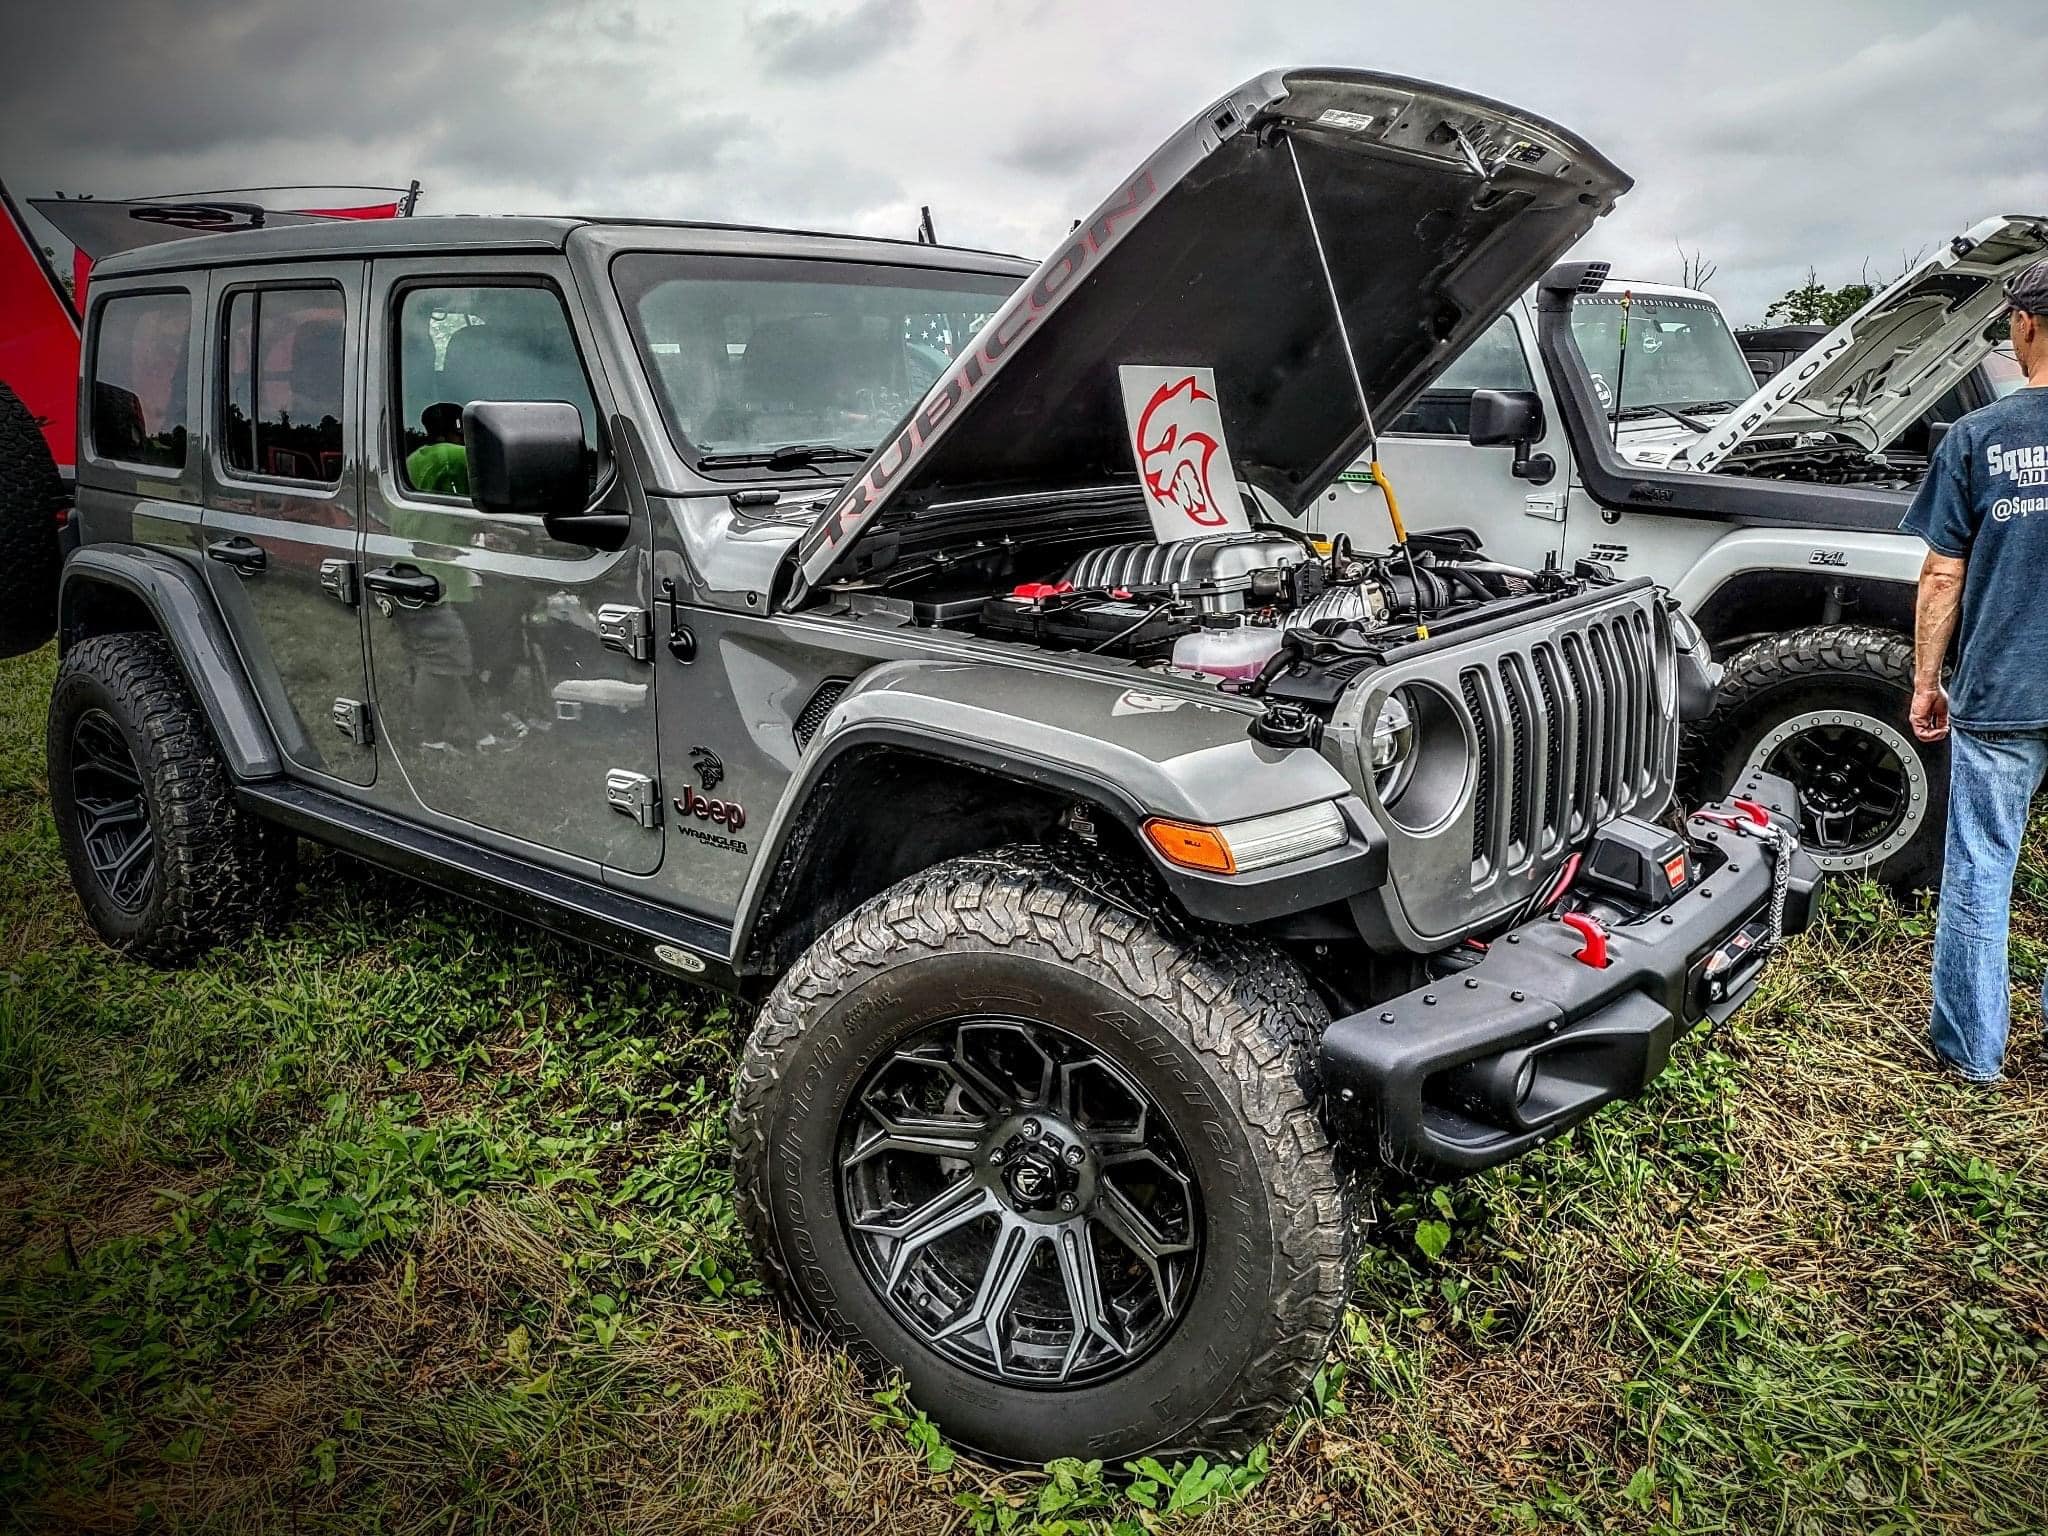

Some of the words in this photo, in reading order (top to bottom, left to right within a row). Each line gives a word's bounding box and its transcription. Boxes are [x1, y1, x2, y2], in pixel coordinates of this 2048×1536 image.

[823, 168, 1157, 549] RUBICON
[1696, 338, 1848, 471] RUBICON
[1987, 444, 2048, 480] Squa
[1587, 551, 1629, 562] 392
[1809, 549, 1848, 566] 6.4L
[673, 784, 746, 833] Jeep
[677, 824, 747, 850] WRANGLER
